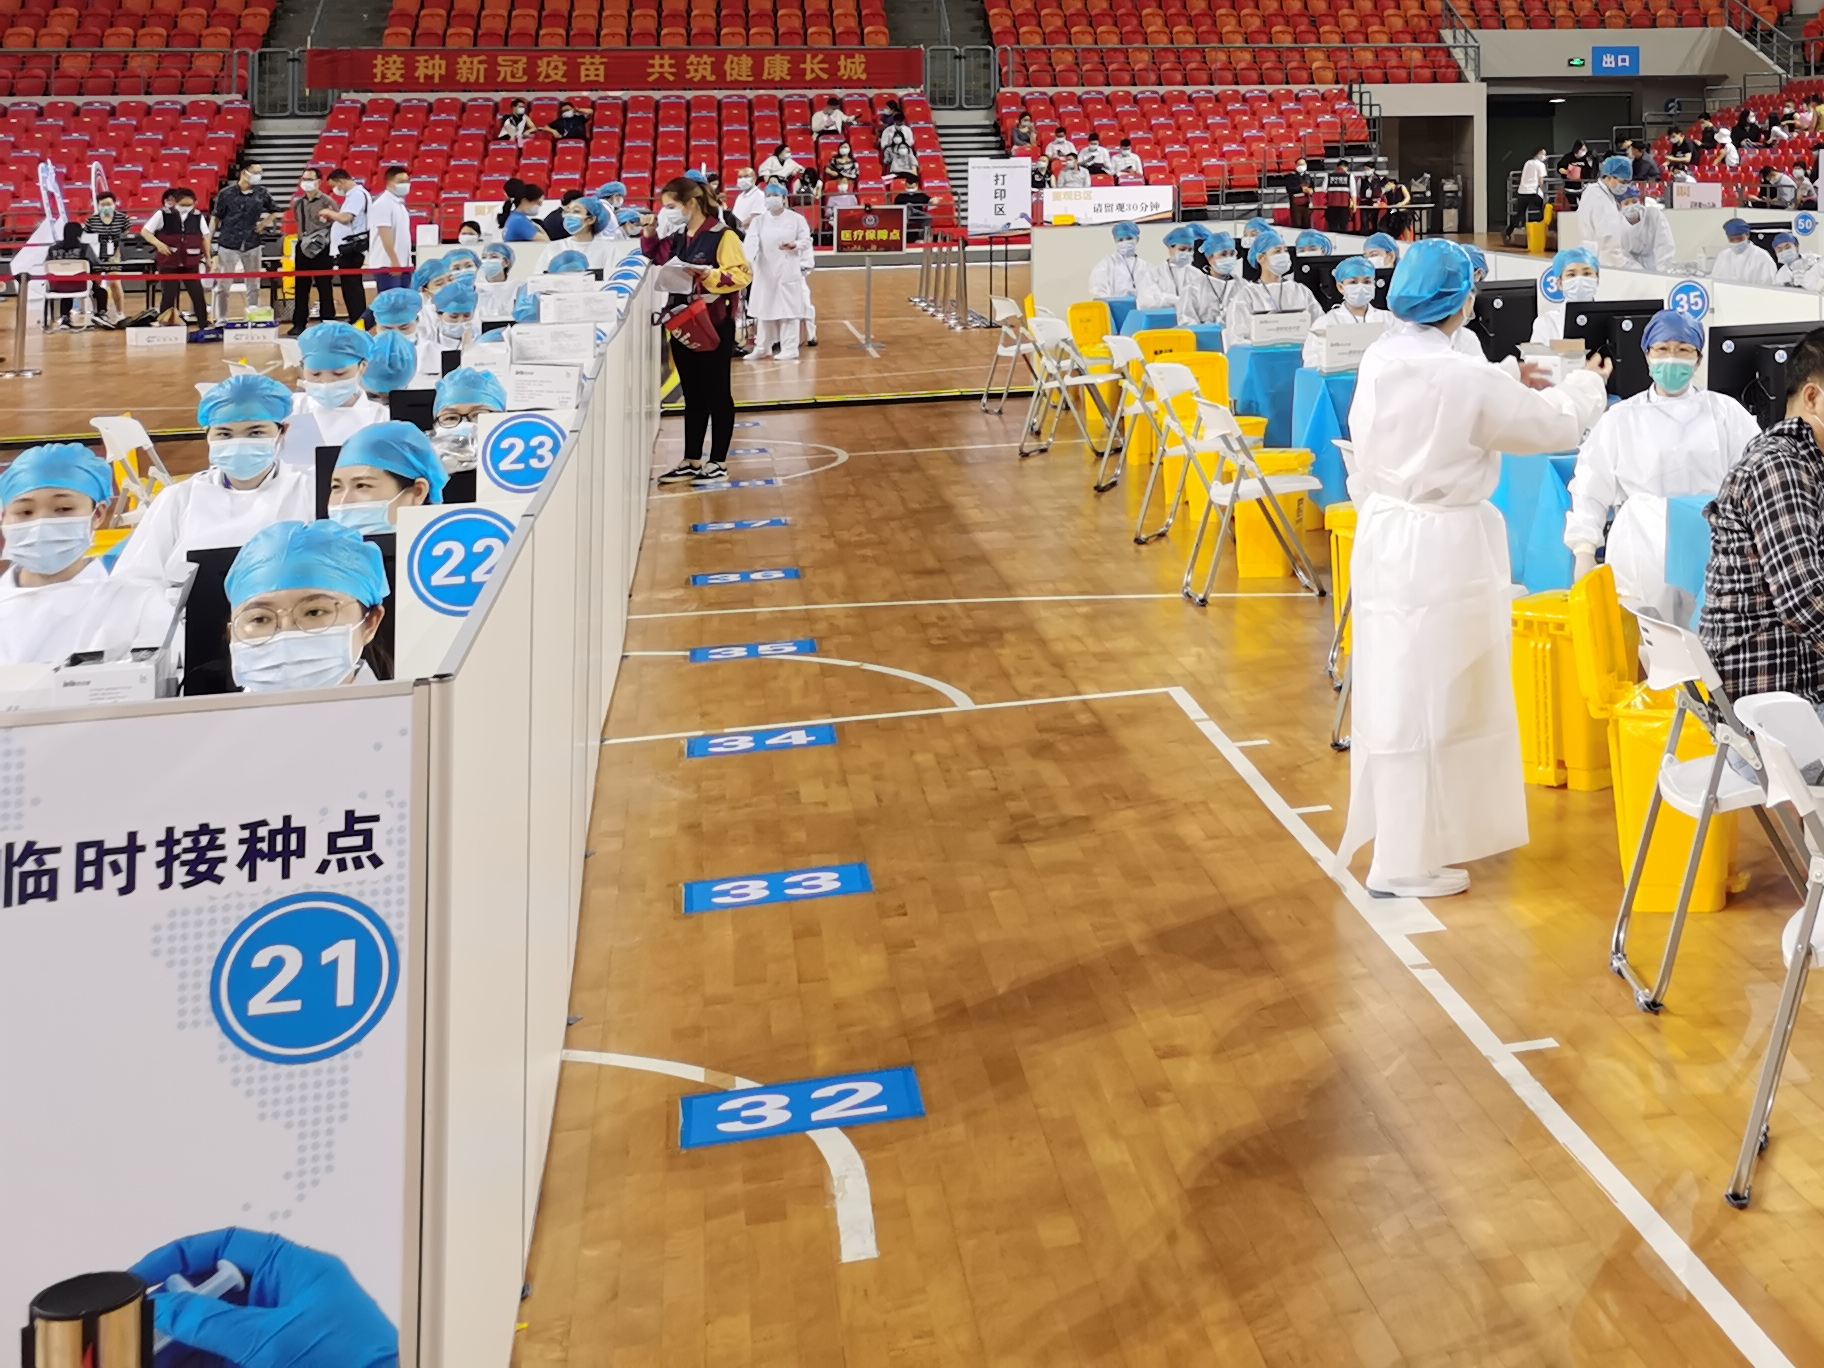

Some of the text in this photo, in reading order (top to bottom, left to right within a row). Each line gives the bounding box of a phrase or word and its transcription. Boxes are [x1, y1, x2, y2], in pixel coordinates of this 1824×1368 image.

[373, 53, 868, 83] 接种新冠疫苗 共筑健康长城
[1602, 53, 1630, 68] 出口
[994, 173, 1007, 216] 打印区
[1797, 218, 1813, 233] 50
[1675, 291, 1703, 313] 35
[498, 435, 554, 471] 23
[430, 537, 505, 587] 22
[707, 570, 786, 583] 36
[708, 642, 798, 660] 35
[708, 729, 816, 753] 34
[0, 809, 385, 909] 临时接种点
[711, 871, 842, 904] 33
[246, 938, 357, 1017] 21
[716, 1081, 889, 1133] 32
